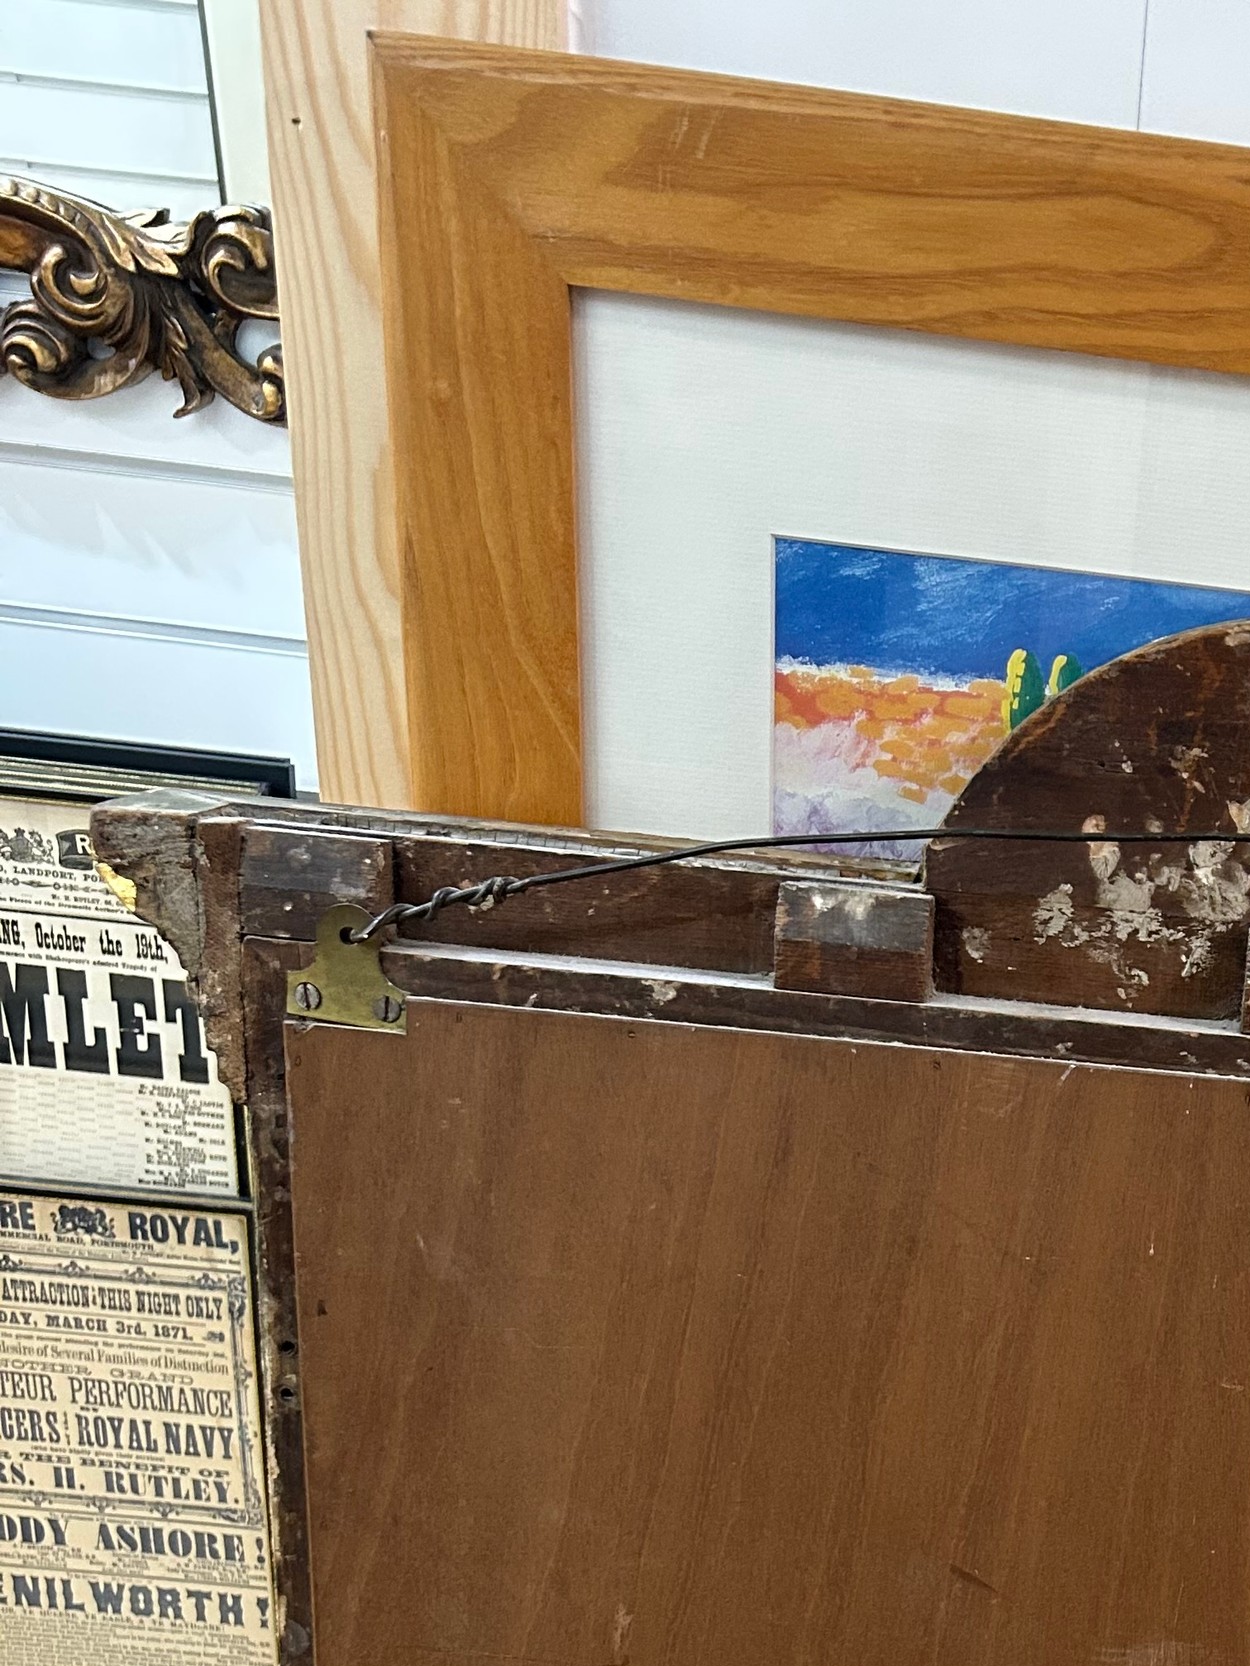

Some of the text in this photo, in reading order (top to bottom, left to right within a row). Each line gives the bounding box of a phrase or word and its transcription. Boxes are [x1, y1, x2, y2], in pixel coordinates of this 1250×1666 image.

[0, 918, 169, 964] NG, October the 19th,
[128, 1212, 240, 1255] ROYAL,
[45, 1314, 108, 1332] MARCH
[98, 1286, 132, 1312] THIS
[135, 1290, 181, 1316] NIGHT
[186, 1294, 223, 1321] ONLY
[50, 1345, 95, 1362] Several
[97, 1348, 149, 1366] Families
[68, 1376, 233, 1419] PERFORMANCE
[75, 1412, 158, 1453] ROYAL
[162, 1421, 235, 1460] NAVY
[19, 1451, 71, 1465] THE
[80, 1456, 191, 1476] BENEFIT
[199, 1467, 230, 1478] OF
